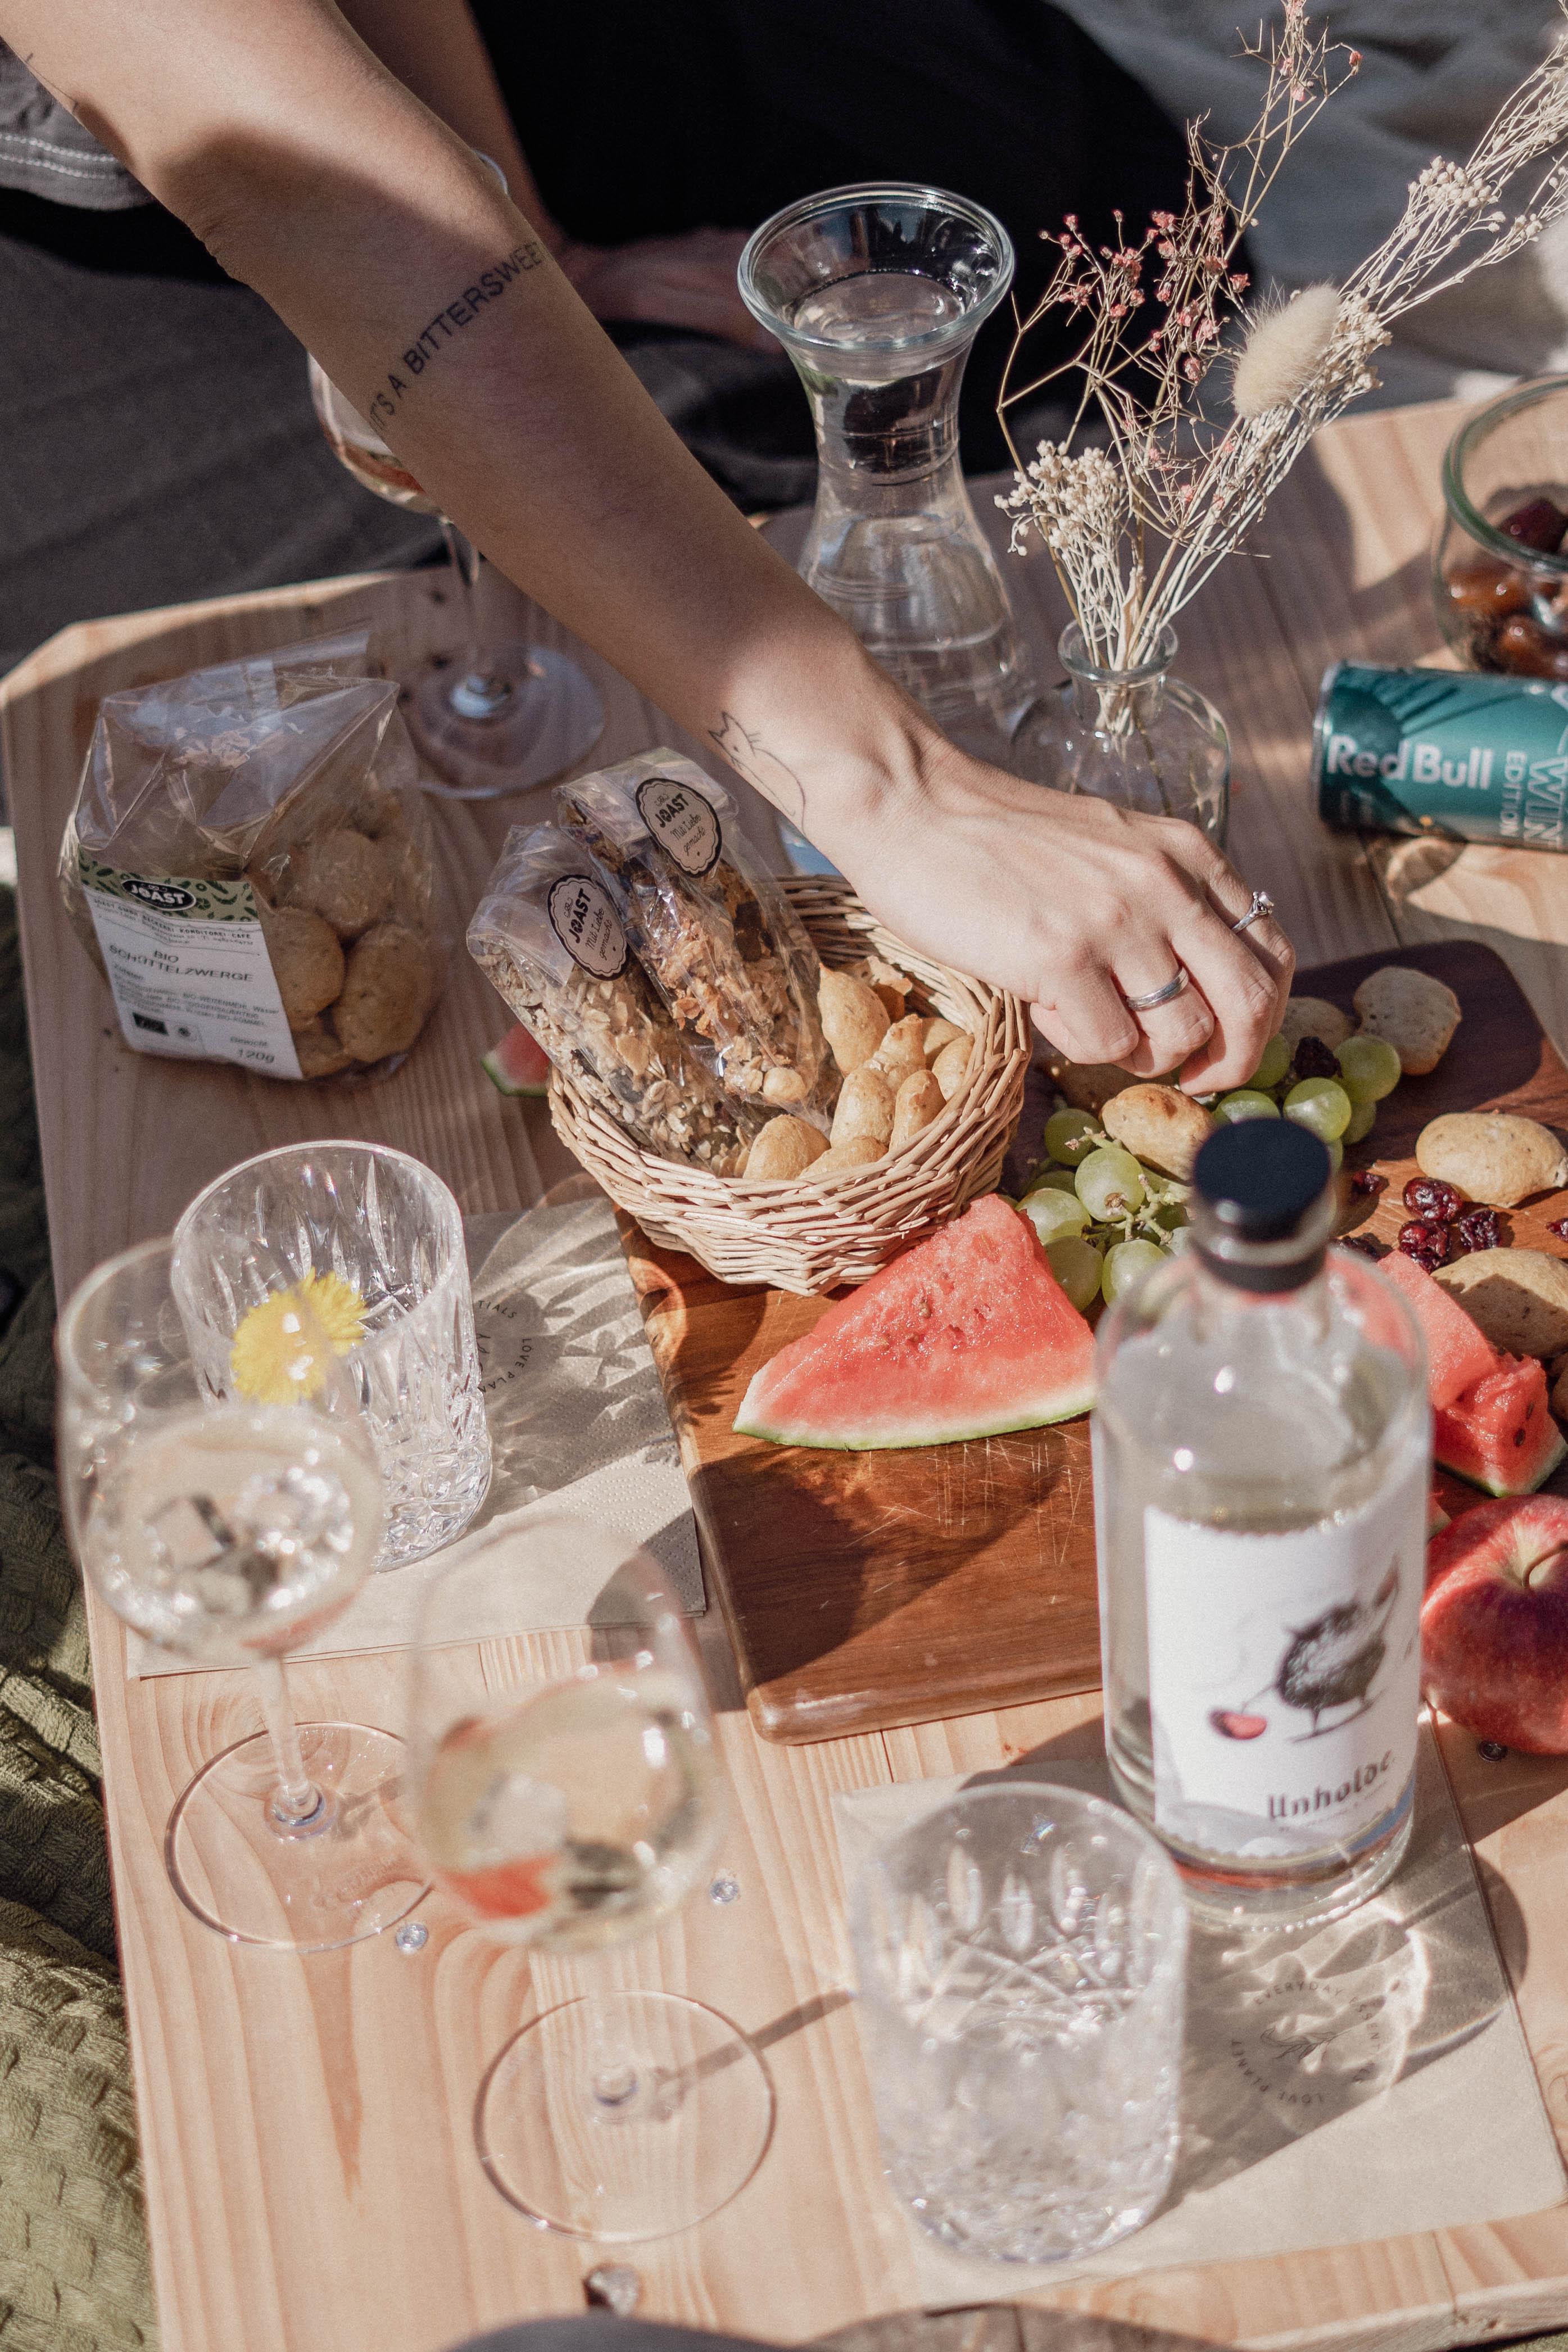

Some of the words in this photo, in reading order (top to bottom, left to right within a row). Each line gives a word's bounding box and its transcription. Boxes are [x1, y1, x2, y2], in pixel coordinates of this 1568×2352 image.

[388, 374, 408, 400] A
[1500, 751, 1528, 837] EDITION
[1524, 756, 1568, 848] WIN
[655, 792, 689, 828] JOAST
[670, 821, 687, 841] Mit
[686, 813, 701, 831] Liebe
[683, 826, 706, 856] gemacht
[131, 884, 185, 904] JOAST
[569, 888, 591, 944] JOAST
[586, 924, 597, 950] Mit
[593, 907, 605, 933] Liebe
[599, 919, 613, 961] gemacht
[109, 944, 253, 981] SCHÜTTELZWERGE
[153, 950, 179, 963] BIO
[238, 1048, 275, 1063] 120g
[478, 1300, 517, 1318] TIALS
[515, 1338, 532, 1368] LOVE
[477, 1371, 515, 1393] PLAN
[1254, 1981, 1344, 2005] EVERYDAY
